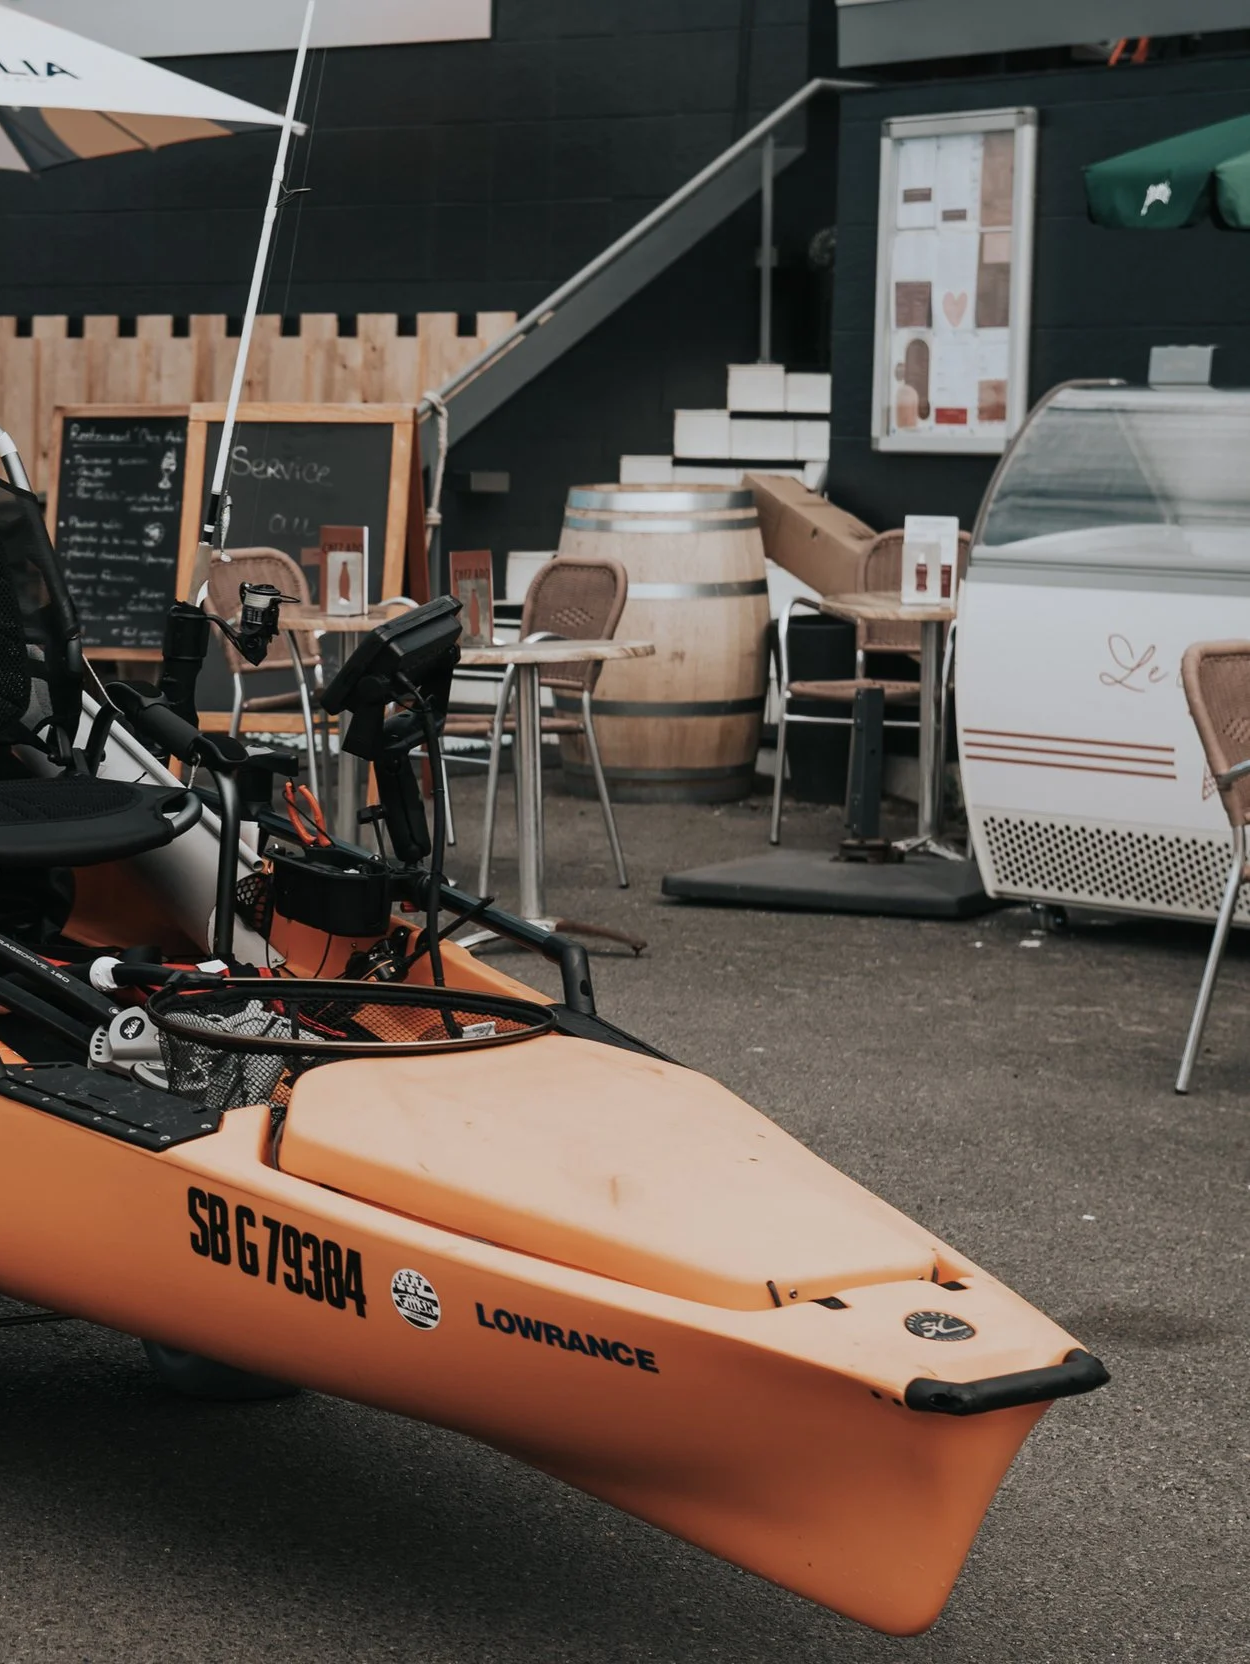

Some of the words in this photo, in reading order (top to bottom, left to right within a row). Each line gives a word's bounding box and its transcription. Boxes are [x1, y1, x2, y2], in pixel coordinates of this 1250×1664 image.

[1099, 633, 1169, 693] Le
[50, 969, 70, 984] 180
[188, 1186, 232, 1266] SB
[235, 1204, 260, 1277] G
[262, 1214, 367, 1319] 79384
[475, 1302, 660, 1374] LOWRANCE
